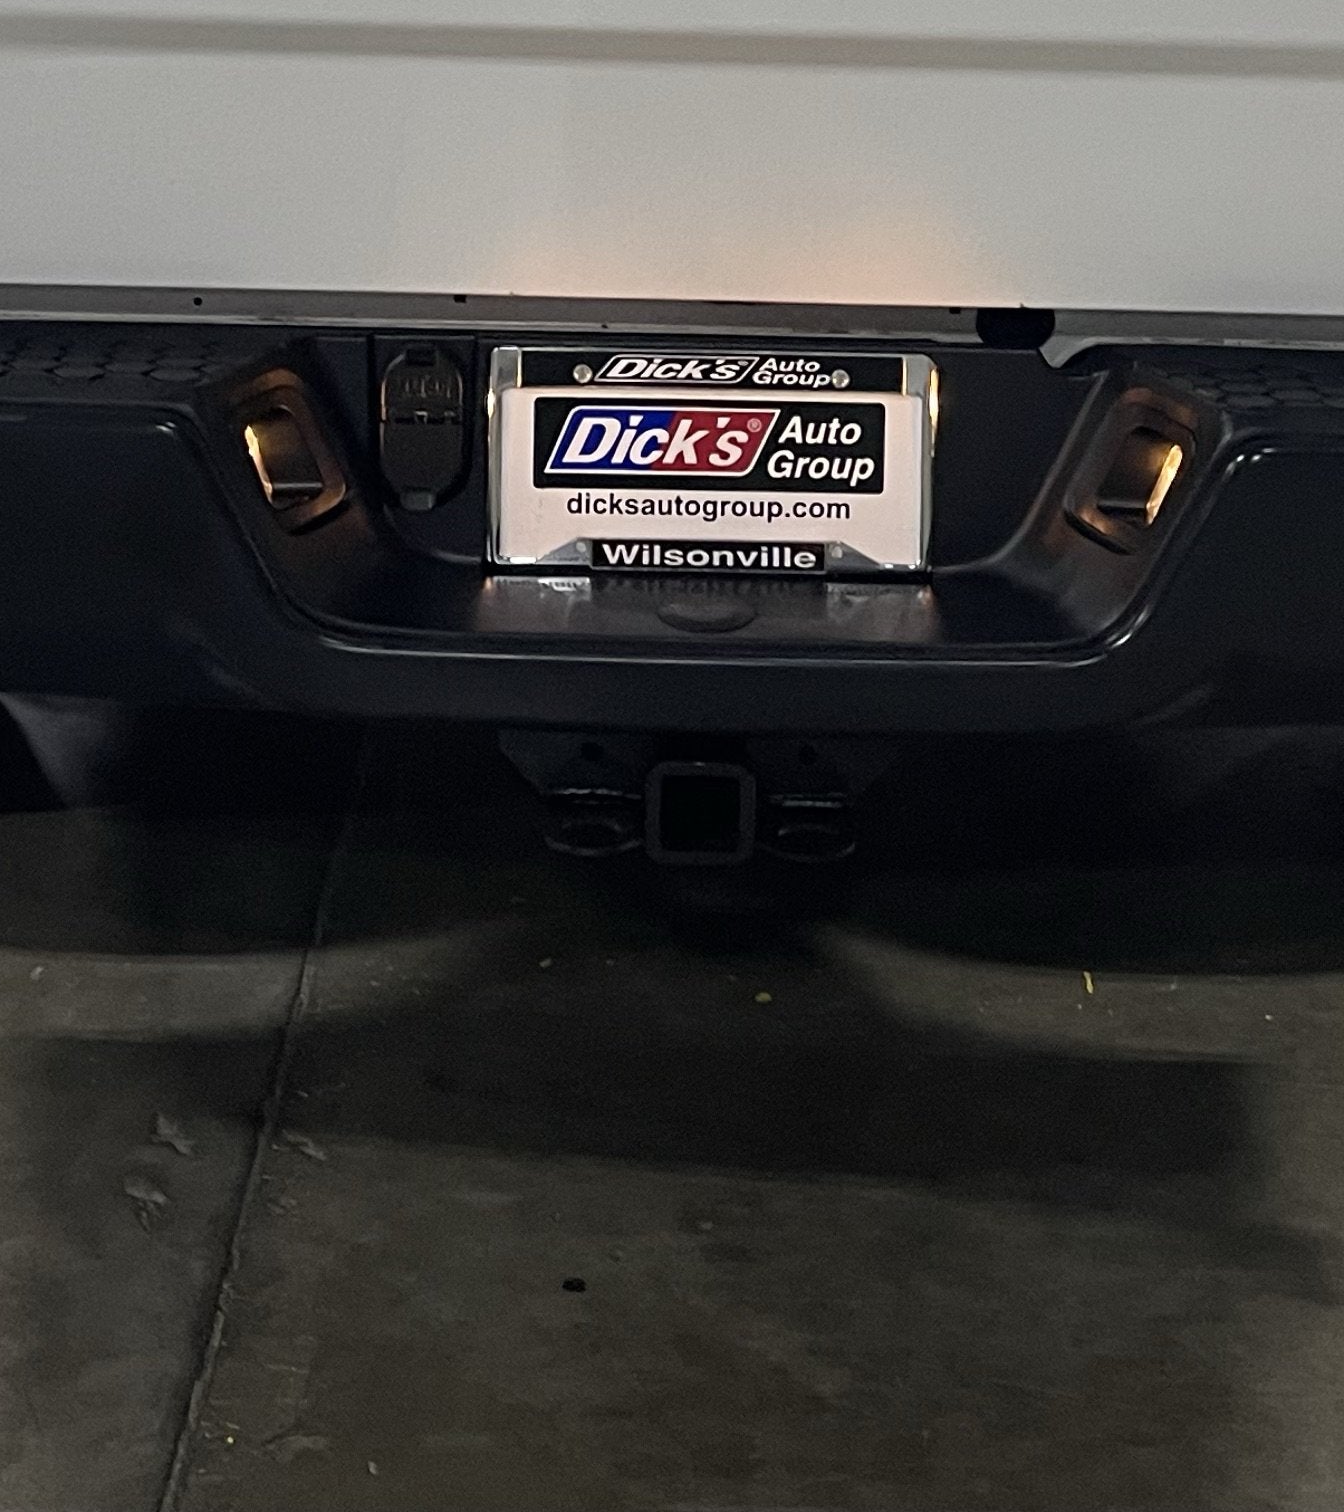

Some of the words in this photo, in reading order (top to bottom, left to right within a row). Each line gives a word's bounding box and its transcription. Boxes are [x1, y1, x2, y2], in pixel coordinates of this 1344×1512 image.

[605, 358, 741, 381] Dick's
[760, 358, 821, 372] Auto
[753, 371, 830, 388] Group
[562, 414, 749, 466] Dick's
[778, 416, 862, 445] Auto
[767, 450, 875, 486] Group
[566, 492, 851, 522] dicksautogroup.com
[601, 543, 817, 569] Wilsonville
